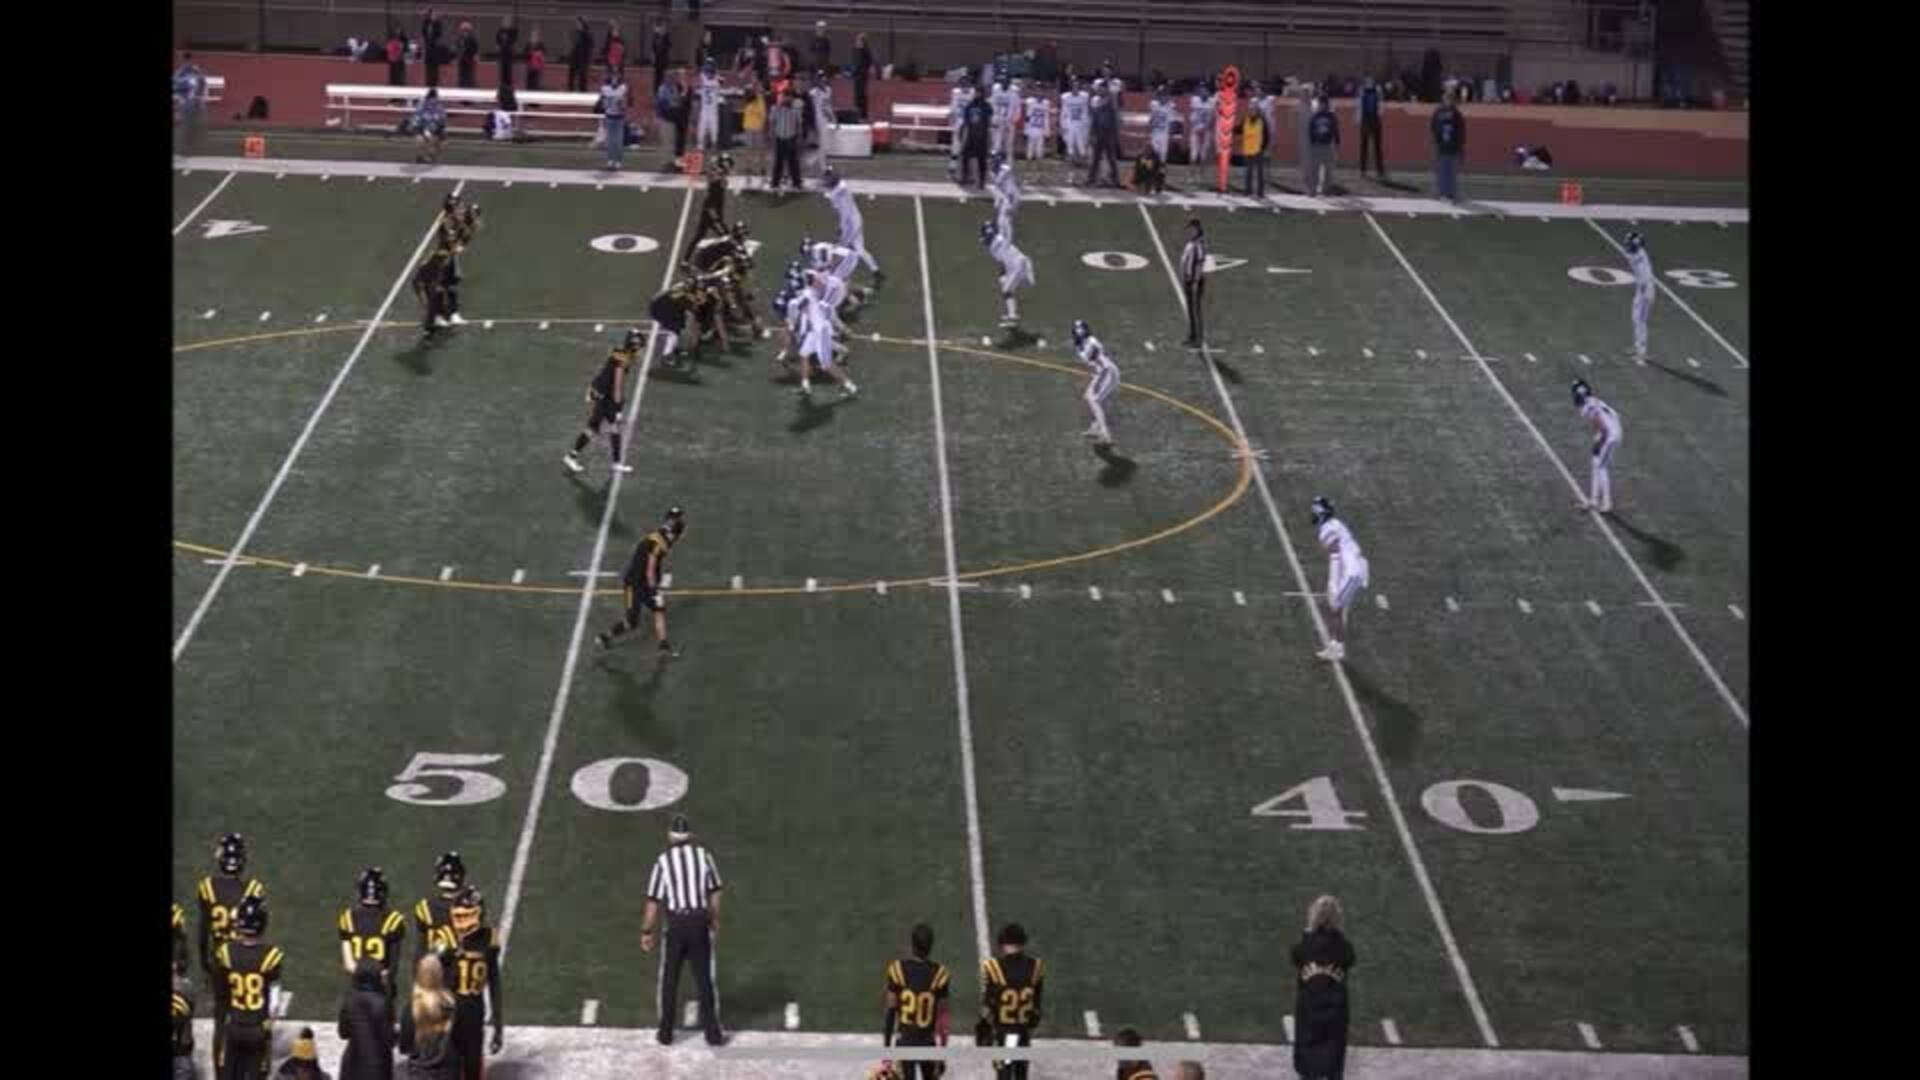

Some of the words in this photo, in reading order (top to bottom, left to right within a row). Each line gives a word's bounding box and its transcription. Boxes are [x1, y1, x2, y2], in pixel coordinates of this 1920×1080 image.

[386, 752, 689, 811] 50
[228, 971, 265, 1010] 28
[900, 989, 935, 1027] 20
[1000, 987, 1034, 1024] 22
